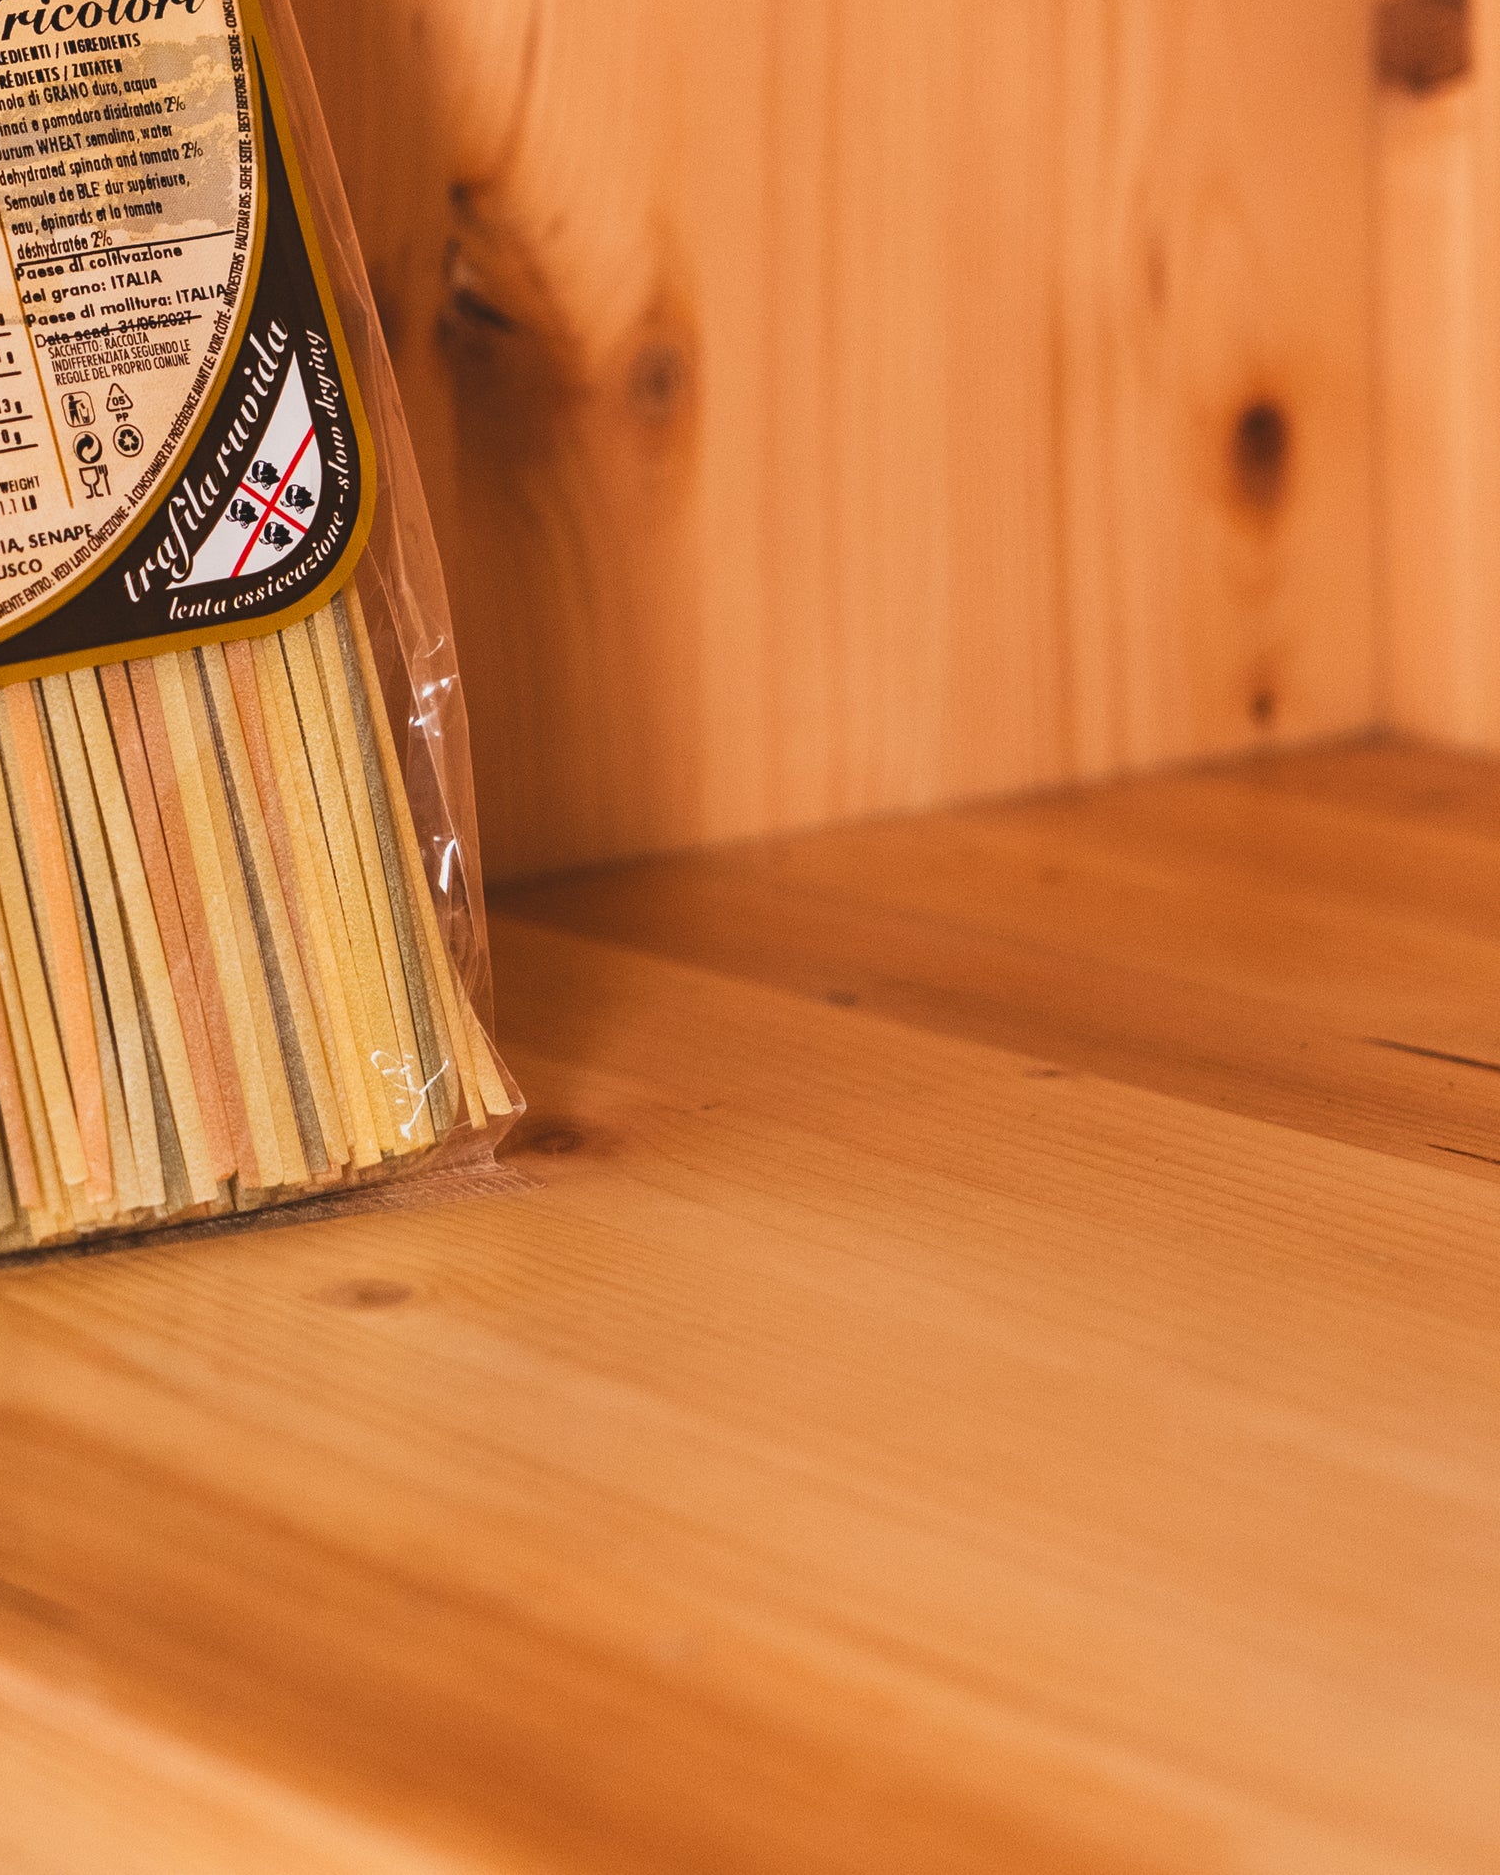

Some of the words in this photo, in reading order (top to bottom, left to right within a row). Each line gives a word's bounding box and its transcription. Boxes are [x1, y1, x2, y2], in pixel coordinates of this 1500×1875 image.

[63, 32, 140, 54] INGREDIENTS
[72, 59, 122, 77] ZUTATEN
[28, 89, 39, 105] di
[43, 82, 88, 102] GRANO
[92, 81, 121, 95] duro,
[123, 77, 156, 94] acqua
[42, 108, 101, 133] pomodoro
[103, 101, 162, 119] disidratato
[164, 94, 186, 112] 2%
[36, 133, 81, 154] WHEAT
[85, 127, 139, 146] semolina,
[140, 124, 171, 138] water
[0, 161, 65, 186] dehydrated
[69, 154, 112, 177] spinach
[115, 150, 137, 167] and
[139, 147, 178, 164] tomato
[180, 140, 204, 159] 2%
[4, 190, 55, 210] Semoule
[59, 186, 73, 201] de
[105, 179, 123, 194] dur
[127, 172, 189, 194] supérieure,
[11, 221, 38, 235] eau,
[41, 208, 92, 233] épinards
[96, 207, 106, 221] et
[108, 204, 121, 218] la
[123, 200, 162, 217] tomate
[17, 235, 87, 260] déshydratée
[90, 229, 112, 247] 2%
[15, 265, 63, 280] Paese
[66, 256, 83, 272] di
[89, 247, 182, 268] coltivazione
[22, 288, 45, 303] del
[51, 282, 105, 303] grano:
[110, 270, 161, 288] ITALIA
[26, 312, 75, 327] Paese
[100, 296, 171, 314] molitura:
[176, 284, 229, 303] ITALIA
[48, 340, 98, 358] SACCHETTO:
[104, 332, 148, 349] RACCOLTA
[52, 348, 130, 371] INDIFFERENZIATA
[130, 341, 178, 358] SEGUENDO
[55, 369, 90, 385] REGOLE
[91, 366, 109, 379] DEL
[111, 358, 151, 375] PROPRIO
[153, 353, 189, 368] COMUNE
[307, 329, 339, 417] drying
[111, 395, 126, 406] 05
[115, 412, 128, 421] PP
[124, 478, 221, 601] trafila
[218, 316, 288, 476] ruvida
[327, 424, 349, 490] slow
[0, 476, 39, 492] WEIGHT
[28, 524, 95, 548] SENAPE
[233, 510, 345, 607] essiccazione
[23, 577, 54, 601] ENTRO:
[170, 596, 227, 619] lenta
